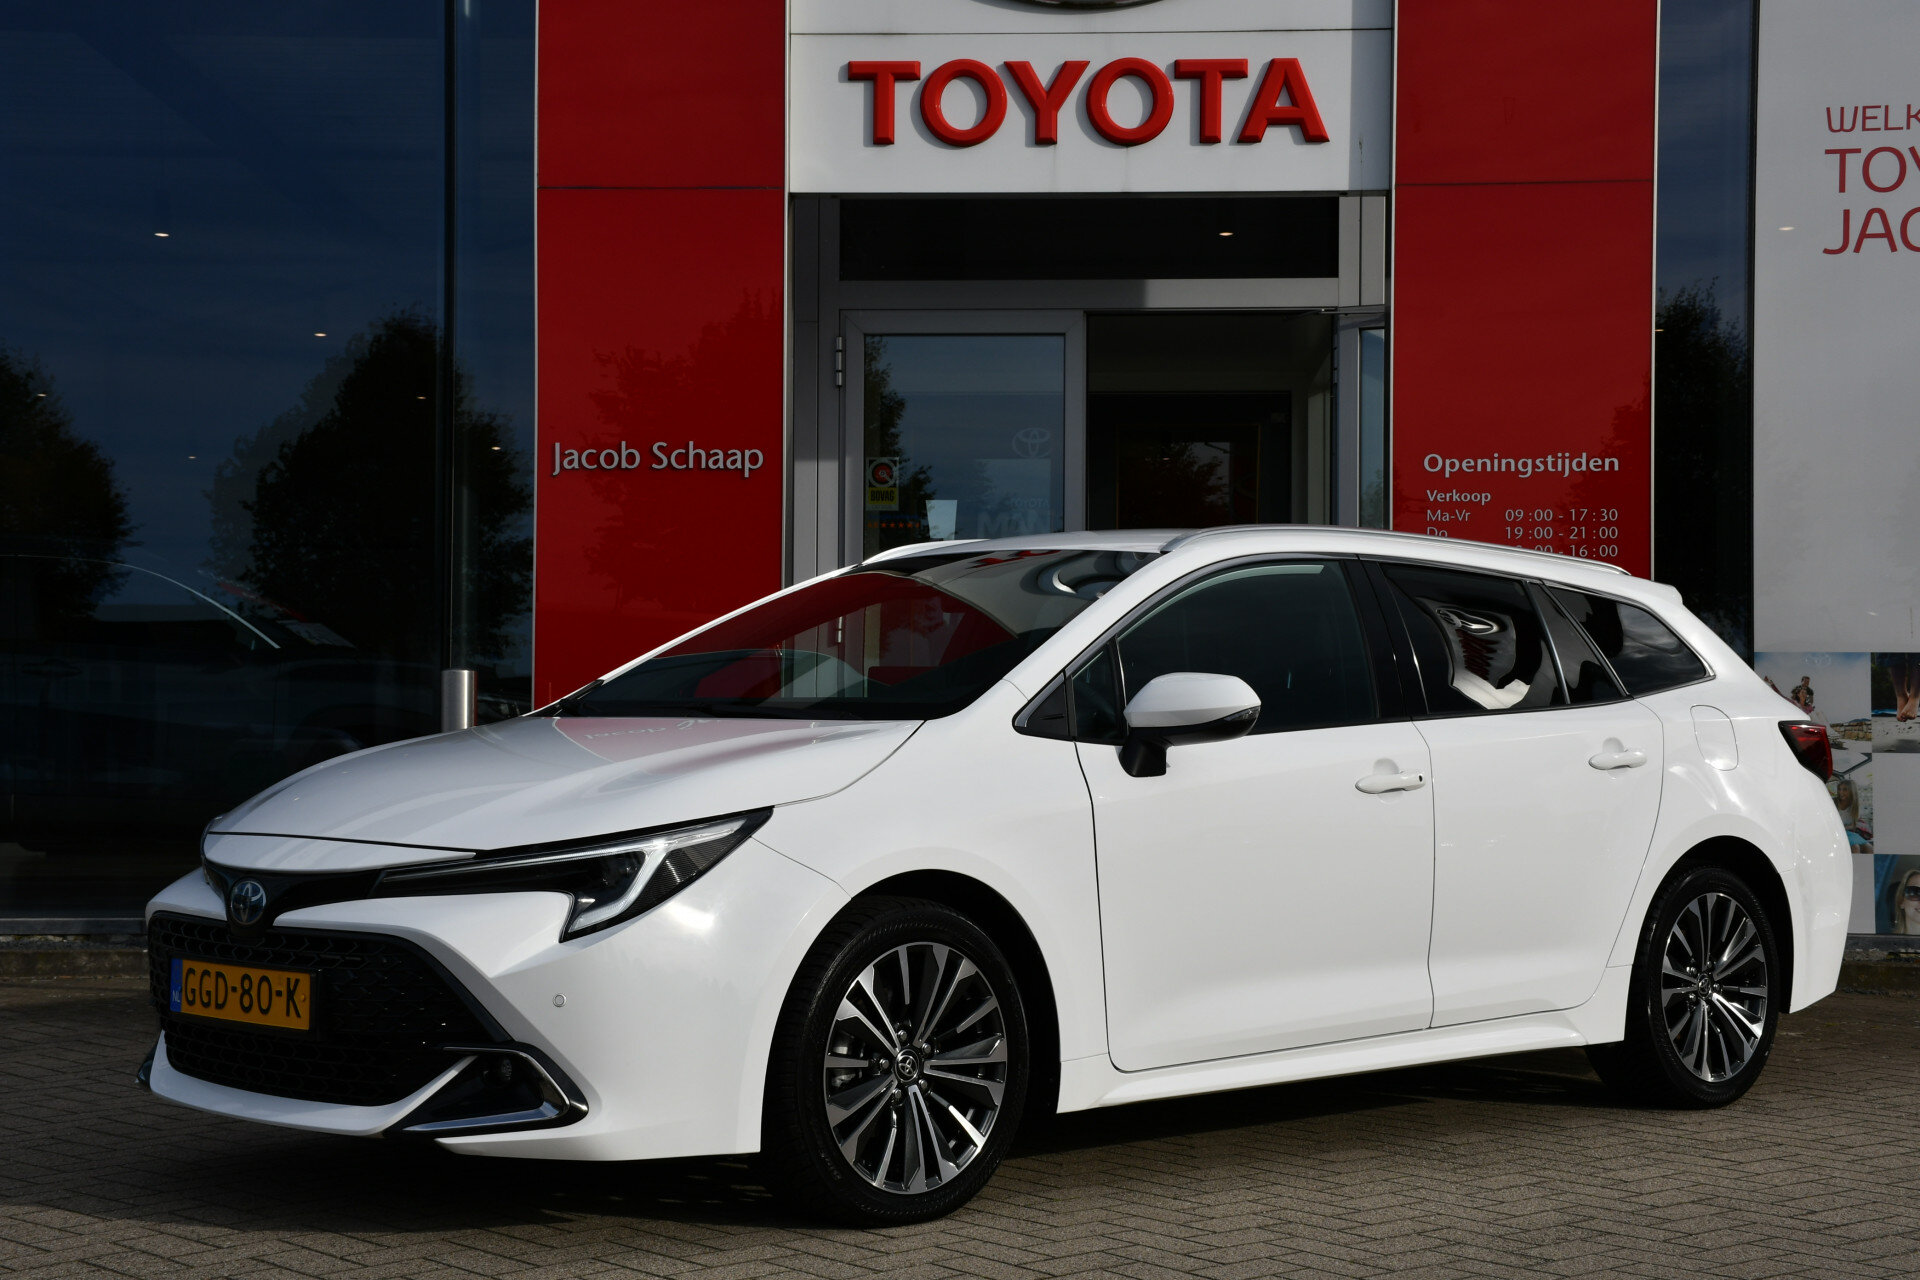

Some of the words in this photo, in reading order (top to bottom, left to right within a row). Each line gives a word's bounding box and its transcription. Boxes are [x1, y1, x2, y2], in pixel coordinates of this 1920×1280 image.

[847, 57, 1330, 146] TOYOTA
[552, 440, 641, 476] Jacob
[651, 440, 764, 478] Schaap
[1423, 452, 1619, 478] Openingstijden
[870, 489, 896, 502] BOVAG
[1426, 489, 1491, 505] Verkoop
[1426, 509, 1471, 522] Ma-Vr
[1426, 526, 1448, 538] Do
[171, 989, 182, 1003] NL
[184, 967, 302, 1018] GGD-80-K
